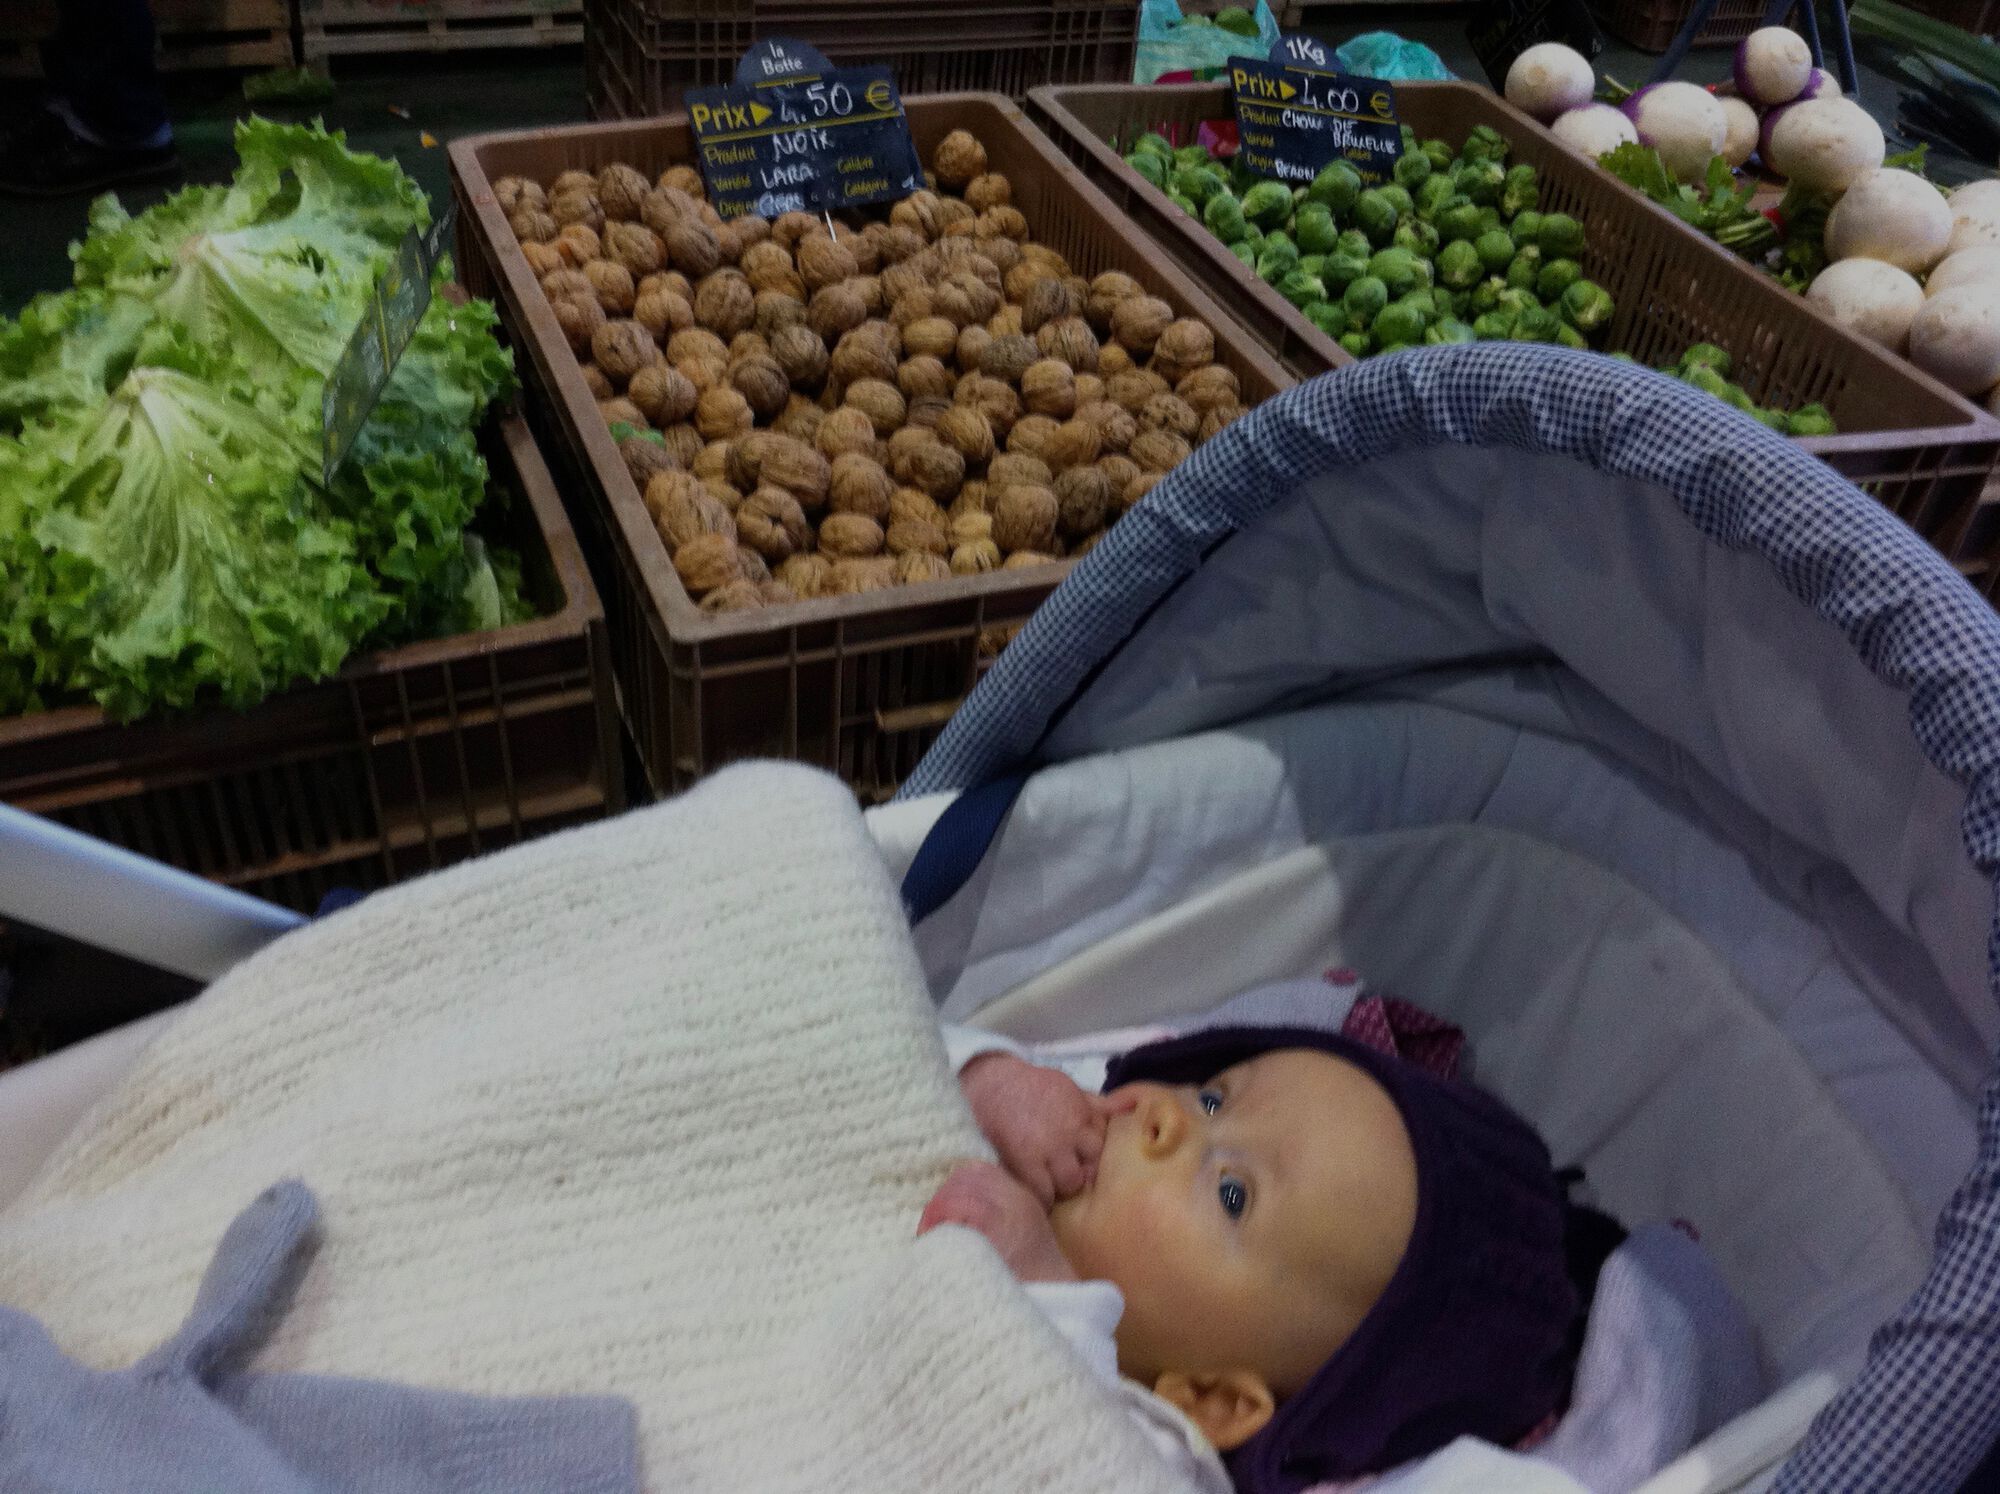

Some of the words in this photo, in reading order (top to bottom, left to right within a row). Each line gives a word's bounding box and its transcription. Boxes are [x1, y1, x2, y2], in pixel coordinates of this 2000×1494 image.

[1232, 67, 1279, 99] Prix
[691, 100, 750, 134] Prix
[863, 80, 897, 112] €
